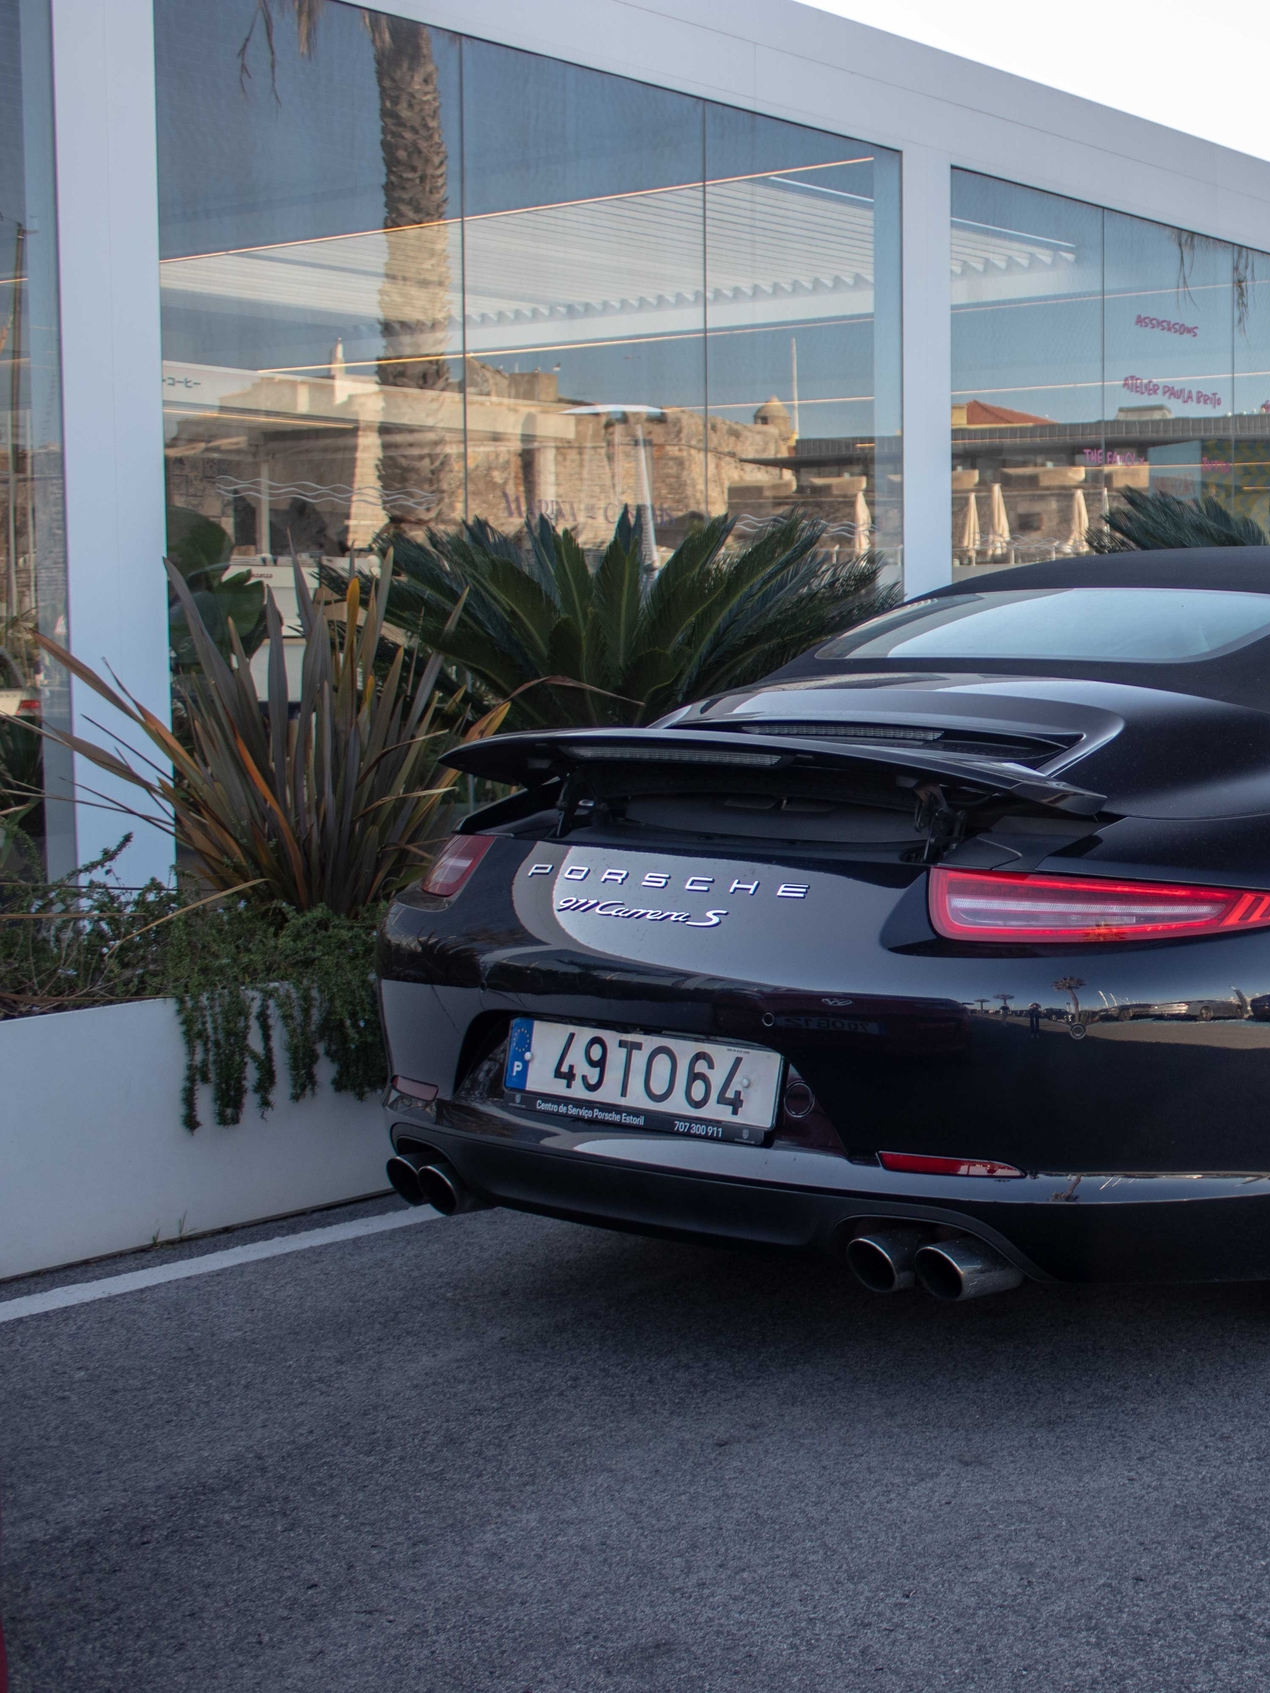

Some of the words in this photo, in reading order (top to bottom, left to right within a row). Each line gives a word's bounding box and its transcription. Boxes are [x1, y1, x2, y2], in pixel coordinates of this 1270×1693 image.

[1122, 375, 1160, 396] ATELIER
[1162, 385, 1194, 404] PAULA
[1196, 390, 1222, 409] BRITO
[1084, 449, 1103, 464] THE
[527, 863, 811, 898] PORSCHE
[557, 897, 600, 912] 911
[595, 900, 691, 923] Carrera
[685, 909, 729, 928] S
[512, 1061, 523, 1077] P
[553, 1032, 744, 1116] 49TO64
[536, 1100, 558, 1112] Centro
[559, 1103, 567, 1114] de
[567, 1104, 593, 1119] Serviço
[593, 1108, 621, 1122] Porsche
[621, 1112, 645, 1126] Estoril
[674, 1121, 690, 1132] 707
[690, 1123, 706, 1135] 300
[707, 1126, 722, 1138] 911
